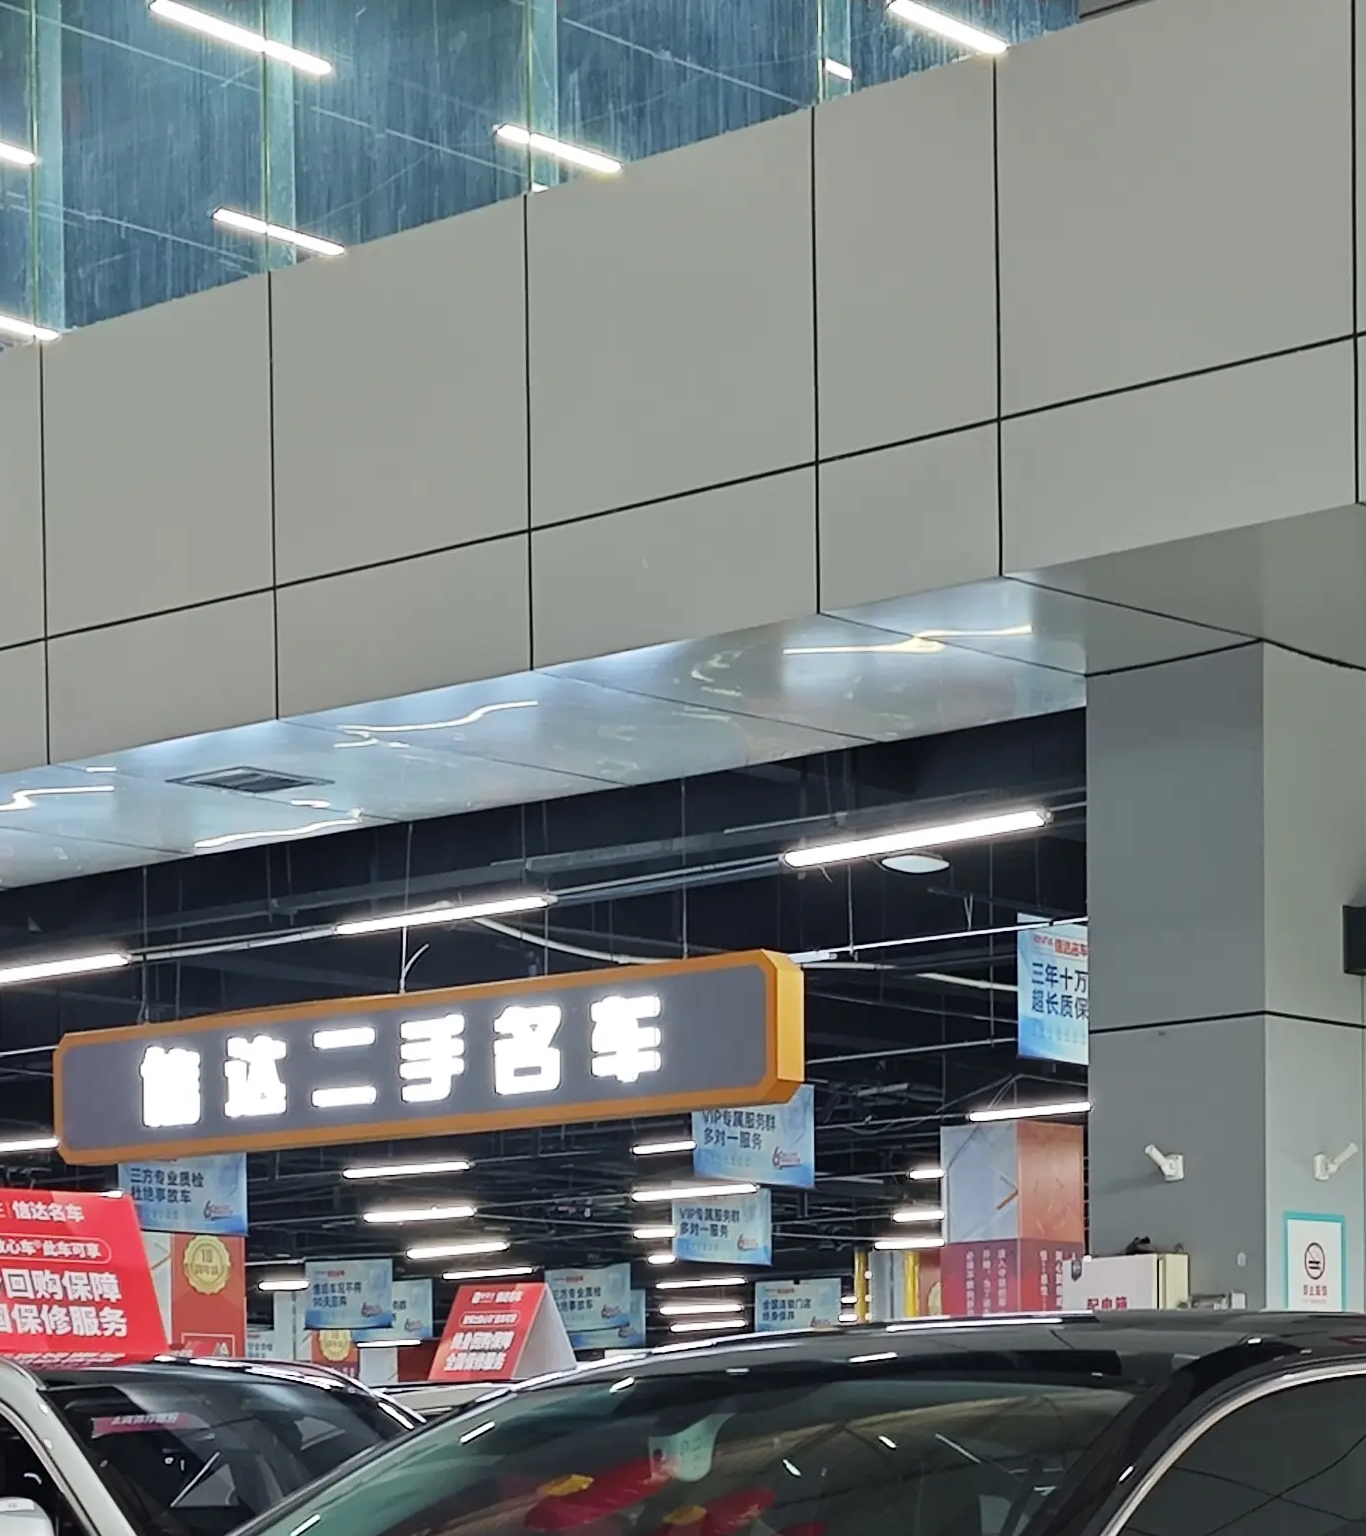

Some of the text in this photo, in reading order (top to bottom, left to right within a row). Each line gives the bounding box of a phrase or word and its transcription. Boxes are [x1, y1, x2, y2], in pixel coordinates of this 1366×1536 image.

[140, 996, 662, 1128] 信达二手名车
